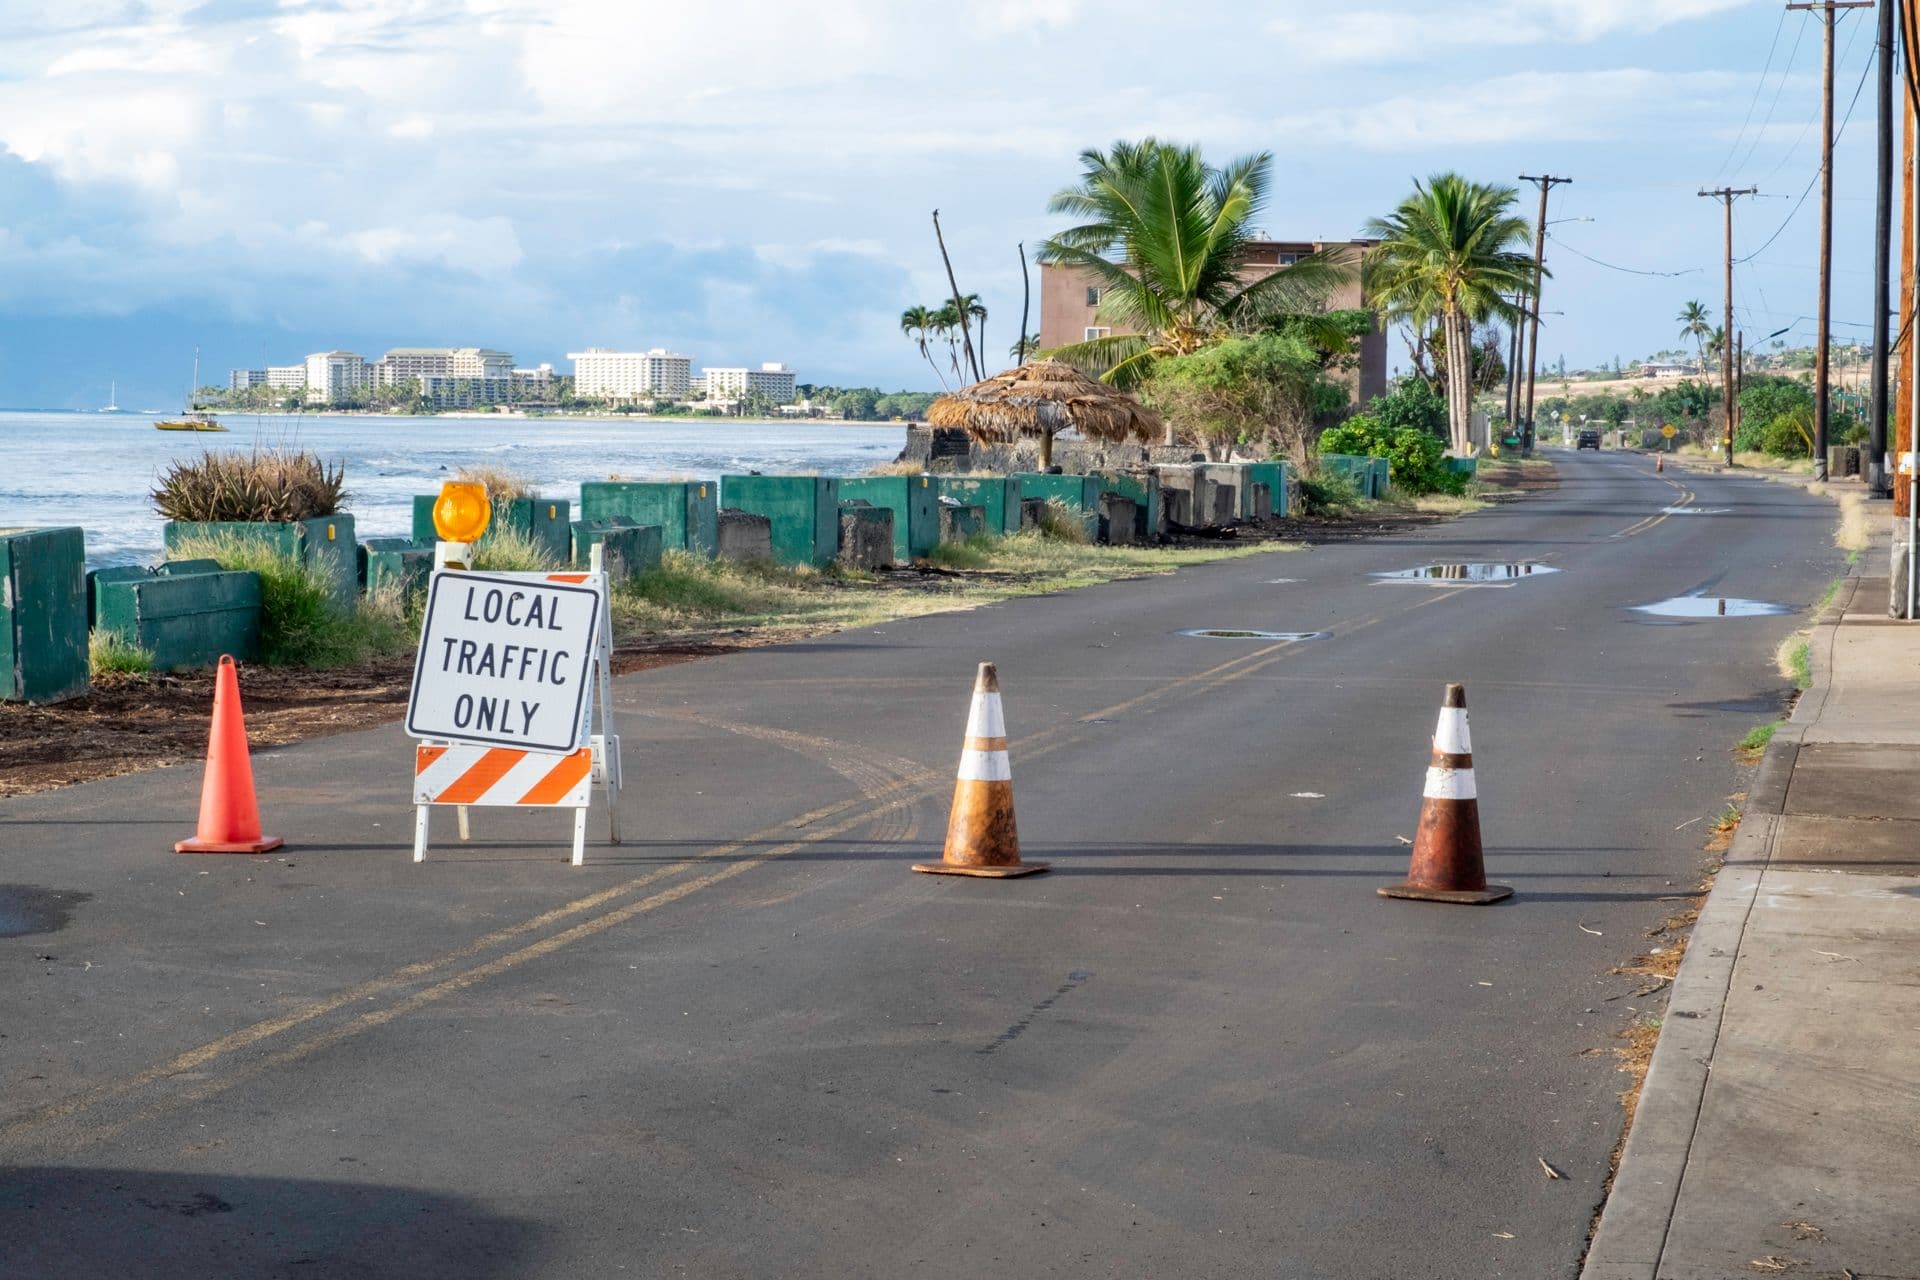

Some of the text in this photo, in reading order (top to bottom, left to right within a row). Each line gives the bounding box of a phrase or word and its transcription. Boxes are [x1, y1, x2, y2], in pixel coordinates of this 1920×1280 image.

[464, 586, 563, 631] LOCAL
[442, 637, 570, 686] TRAFFIC
[454, 693, 541, 736] ONLY
